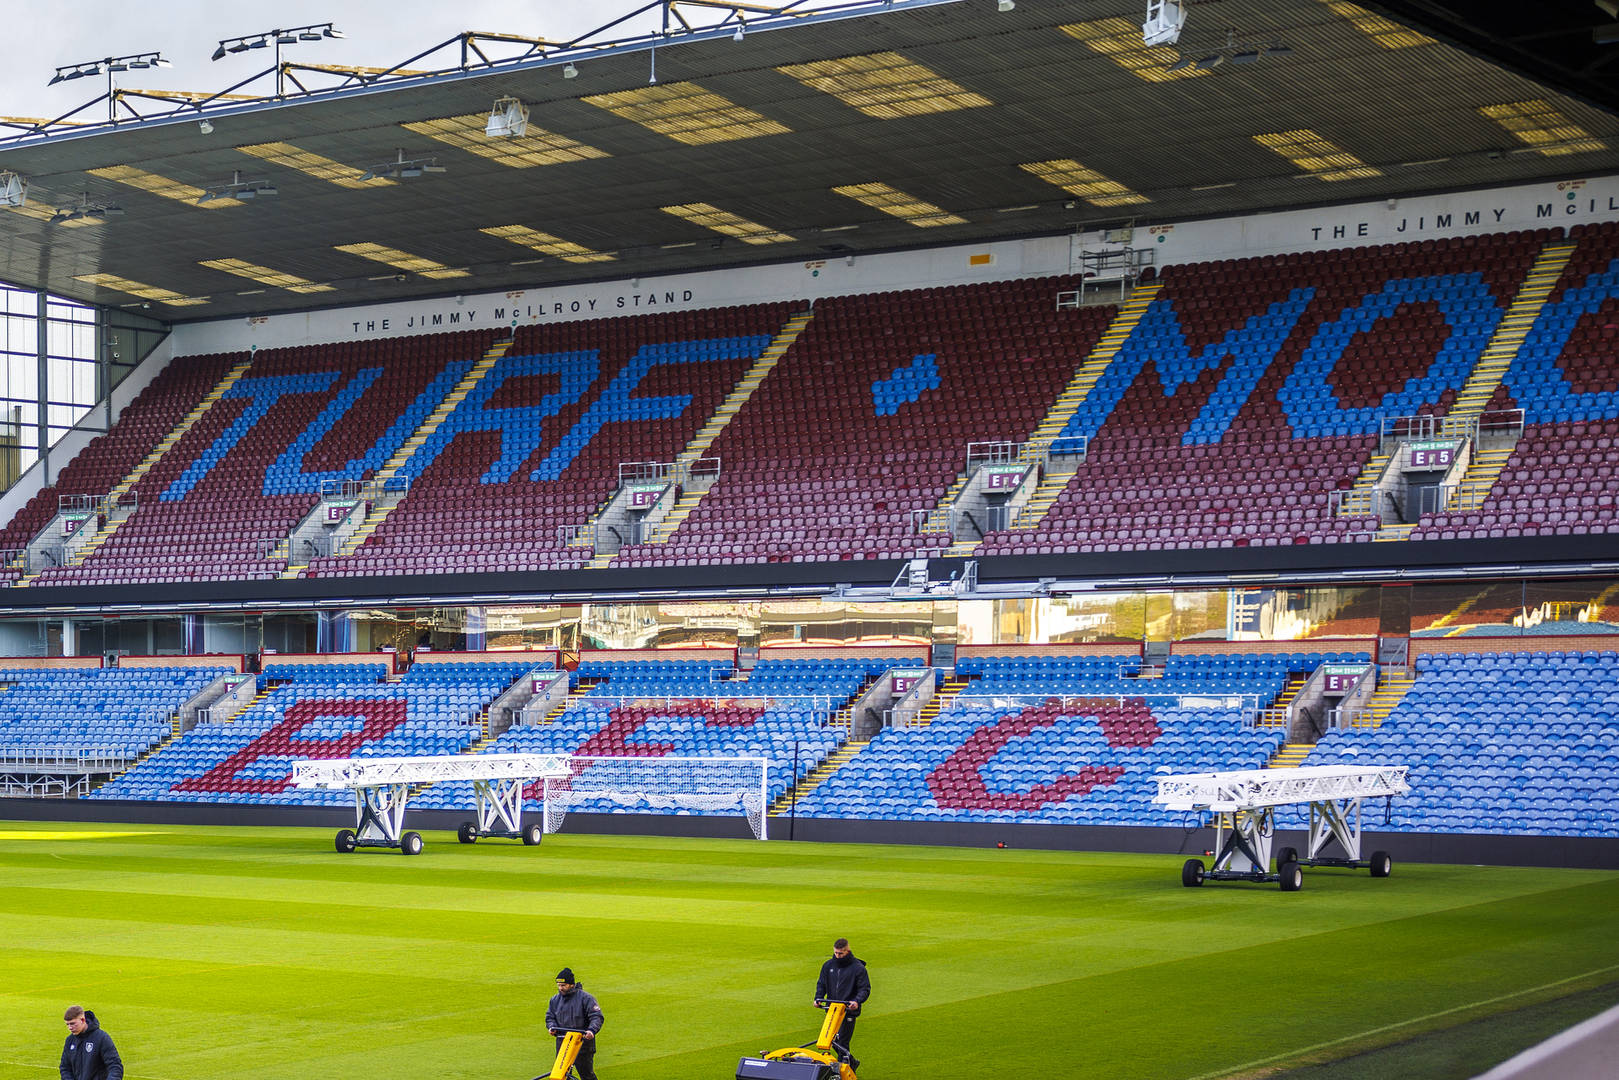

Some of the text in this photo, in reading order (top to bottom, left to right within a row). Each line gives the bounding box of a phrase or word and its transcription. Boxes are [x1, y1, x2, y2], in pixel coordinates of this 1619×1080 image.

[1311, 222, 1368, 241] THE
[1396, 208, 1506, 233] JIMMY
[353, 289, 694, 333] THE JIMMY McILROY STAND
[159, 333, 773, 503] TURF
[1416, 451, 1449, 465] E 5
[992, 474, 1020, 487] E 4
[636, 493, 643, 504] E
[331, 508, 338, 519] E
[68, 521, 73, 531] E
[536, 682, 543, 692] E
[896, 679, 904, 690] E
[1330, 676, 1339, 689] E
